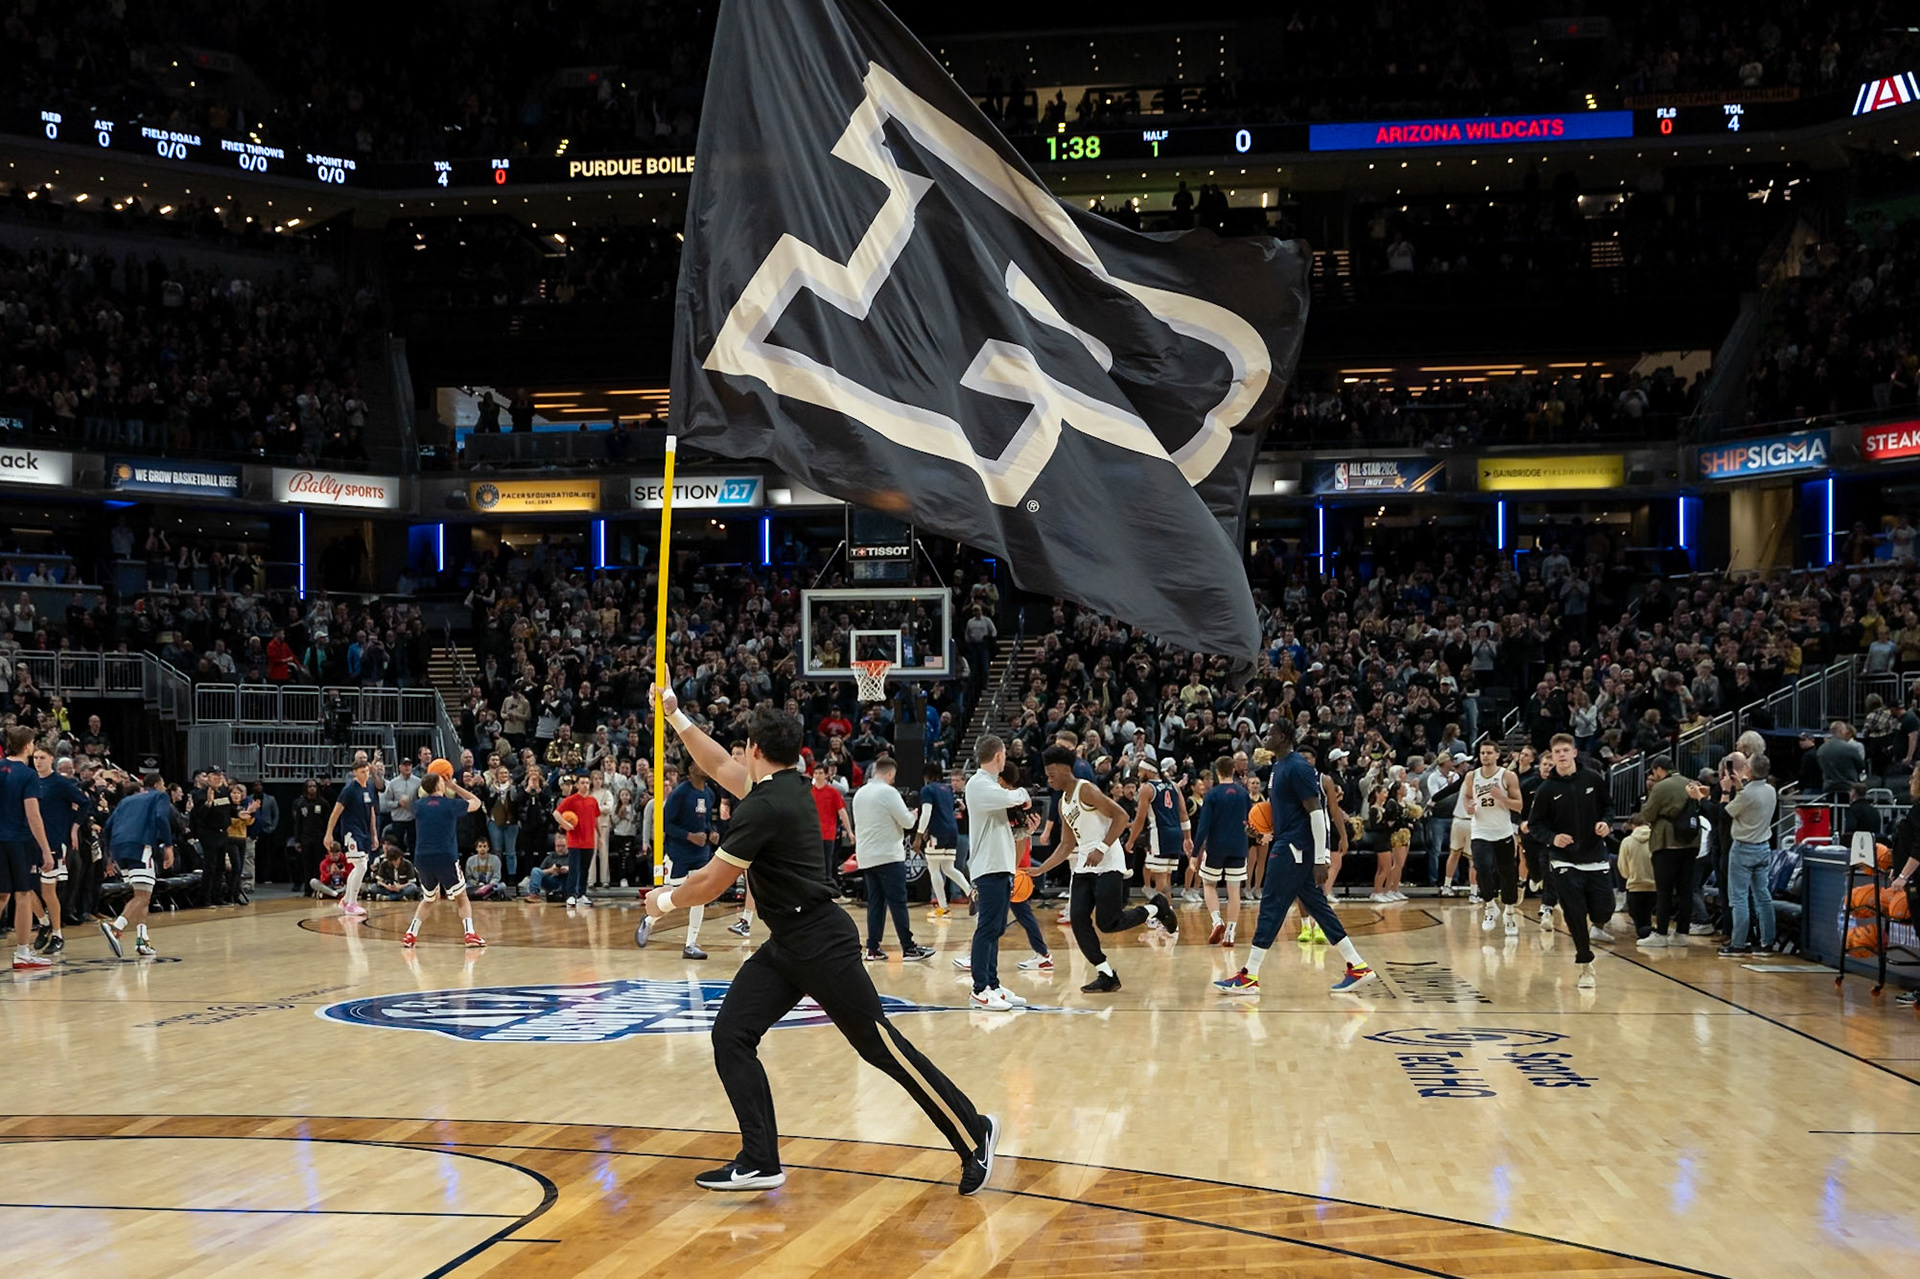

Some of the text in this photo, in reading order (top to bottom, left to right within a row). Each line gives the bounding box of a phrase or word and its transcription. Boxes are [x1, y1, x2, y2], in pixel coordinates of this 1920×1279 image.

[41, 110, 62, 123] REB
[1723, 104, 1744, 115] TOL
[45, 122, 57, 140] 0
[94, 119, 114, 132] AST
[1375, 118, 1564, 144] ARIZONA WILDCATS
[1660, 119, 1673, 135] 0
[1727, 115, 1740, 132] 4
[98, 131, 110, 147] 0
[142, 126, 201, 146] FIELD GOALS
[1143, 130, 1169, 141] HALF
[1235, 129, 1251, 153] 0
[157, 140, 187, 160] 0/0
[221, 139, 285, 159] FREE THROWS
[1047, 135, 1101, 161] 1:38
[1151, 141, 1159, 158] 1
[238, 153, 268, 173] 0/0
[306, 153, 339, 168] 3-POINT
[434, 161, 452, 171] TOL
[569, 158, 643, 178] PURDUE
[317, 165, 346, 184] 0/0
[437, 170, 448, 187] 4
[495, 168, 507, 185] 0
[1700, 438, 1828, 474] SHIPSIGMA
[134, 469, 238, 488] WE GROW BASKETBALL HERE
[288, 472, 385, 502] Bally SPORTS
[723, 483, 752, 500] 127
[866, 546, 909, 556] TISSOT
[1481, 797, 1495, 807] 23
[1395, 1051, 1479, 1075] Tech
[1488, 1052, 1600, 1088] Sports
[1409, 1077, 1498, 1098] HQ
